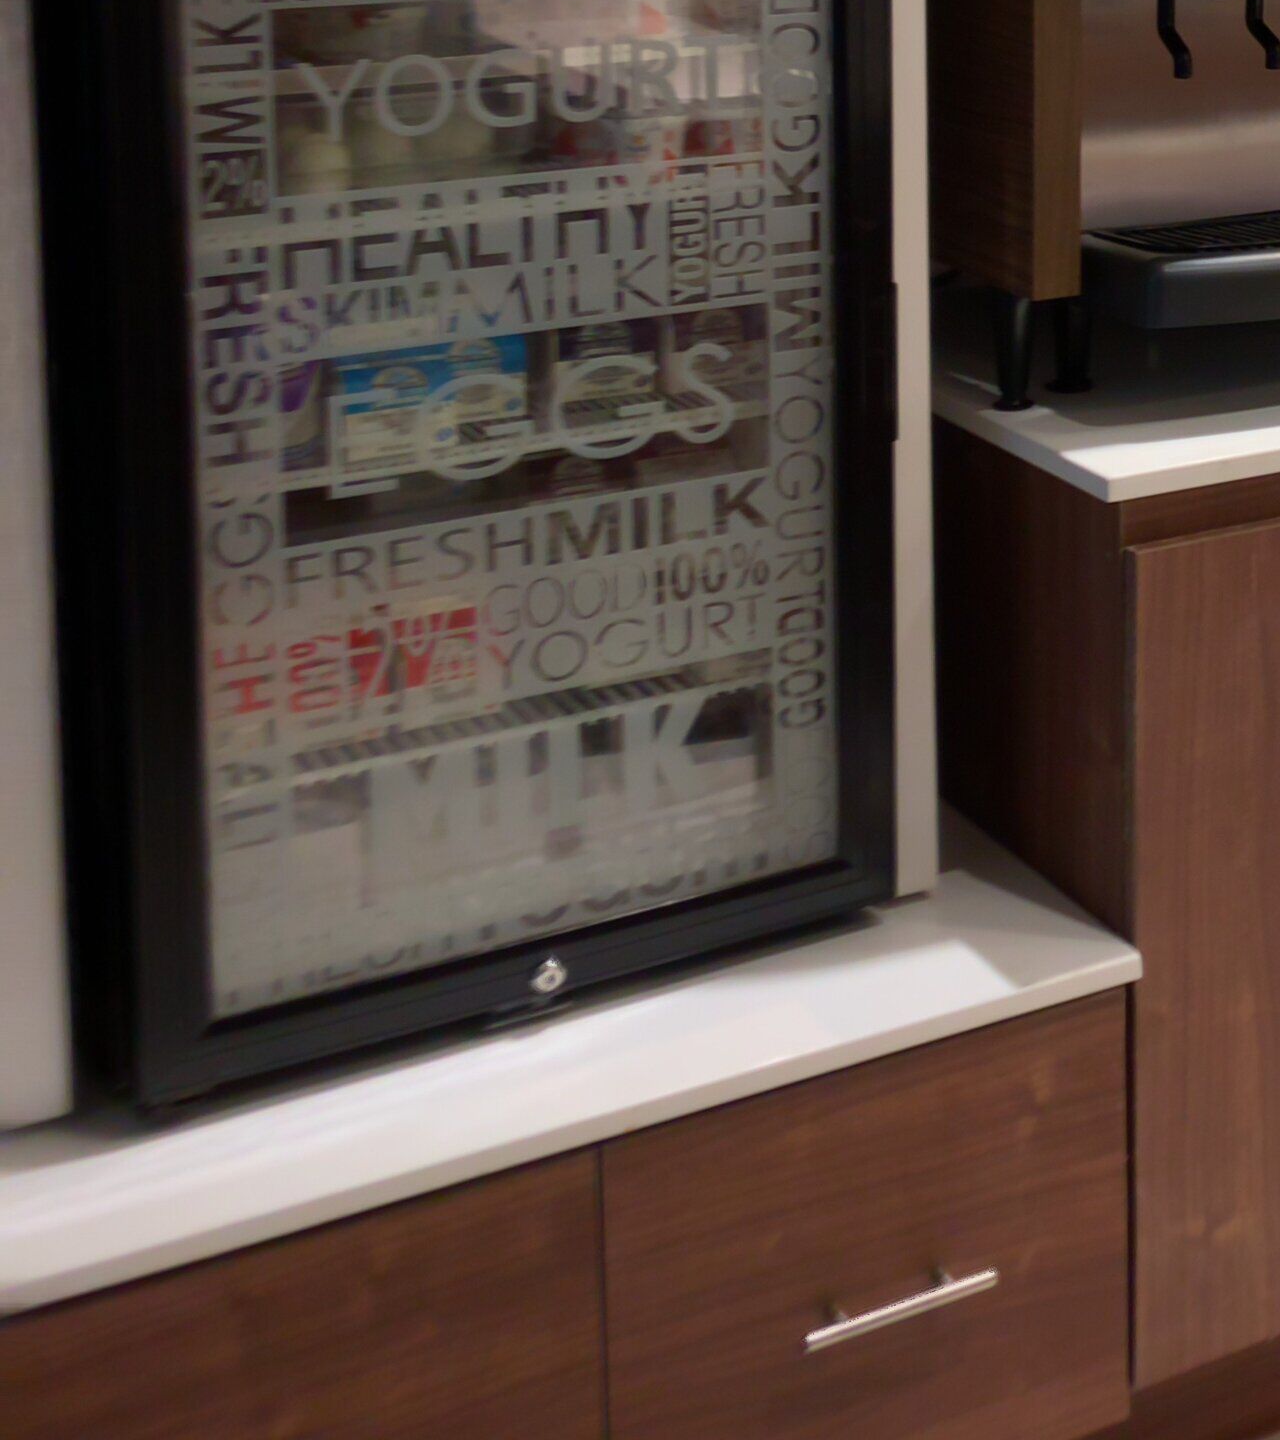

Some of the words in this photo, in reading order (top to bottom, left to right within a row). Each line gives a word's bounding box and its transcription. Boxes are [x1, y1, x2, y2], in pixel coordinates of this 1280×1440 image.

[667, 166, 708, 307] YOGU
[280, 516, 536, 611] FRESH
[543, 474, 771, 568] MILK
[484, 562, 649, 658] GOOD
[484, 591, 770, 694] YOGURT
